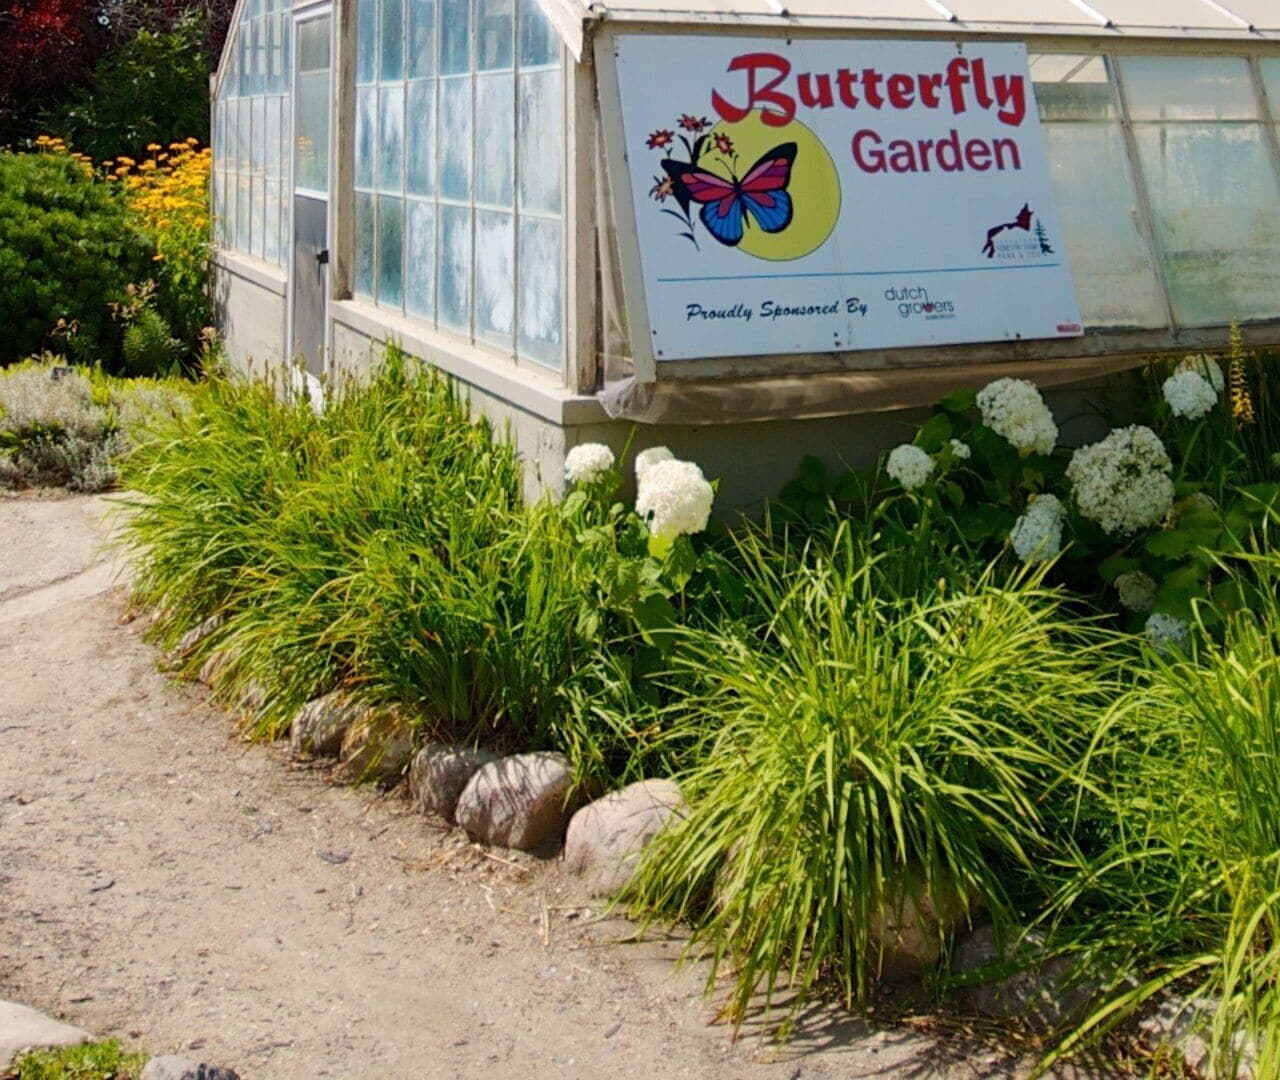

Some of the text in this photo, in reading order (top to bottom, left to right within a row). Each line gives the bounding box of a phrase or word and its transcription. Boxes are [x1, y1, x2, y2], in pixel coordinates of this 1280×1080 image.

[711, 52, 1026, 127] Butterfly
[851, 129, 1022, 173] Garden
[884, 286, 928, 301] dutch
[686, 297, 868, 321] Proudly Sponsored By
[898, 300, 955, 318] growers
